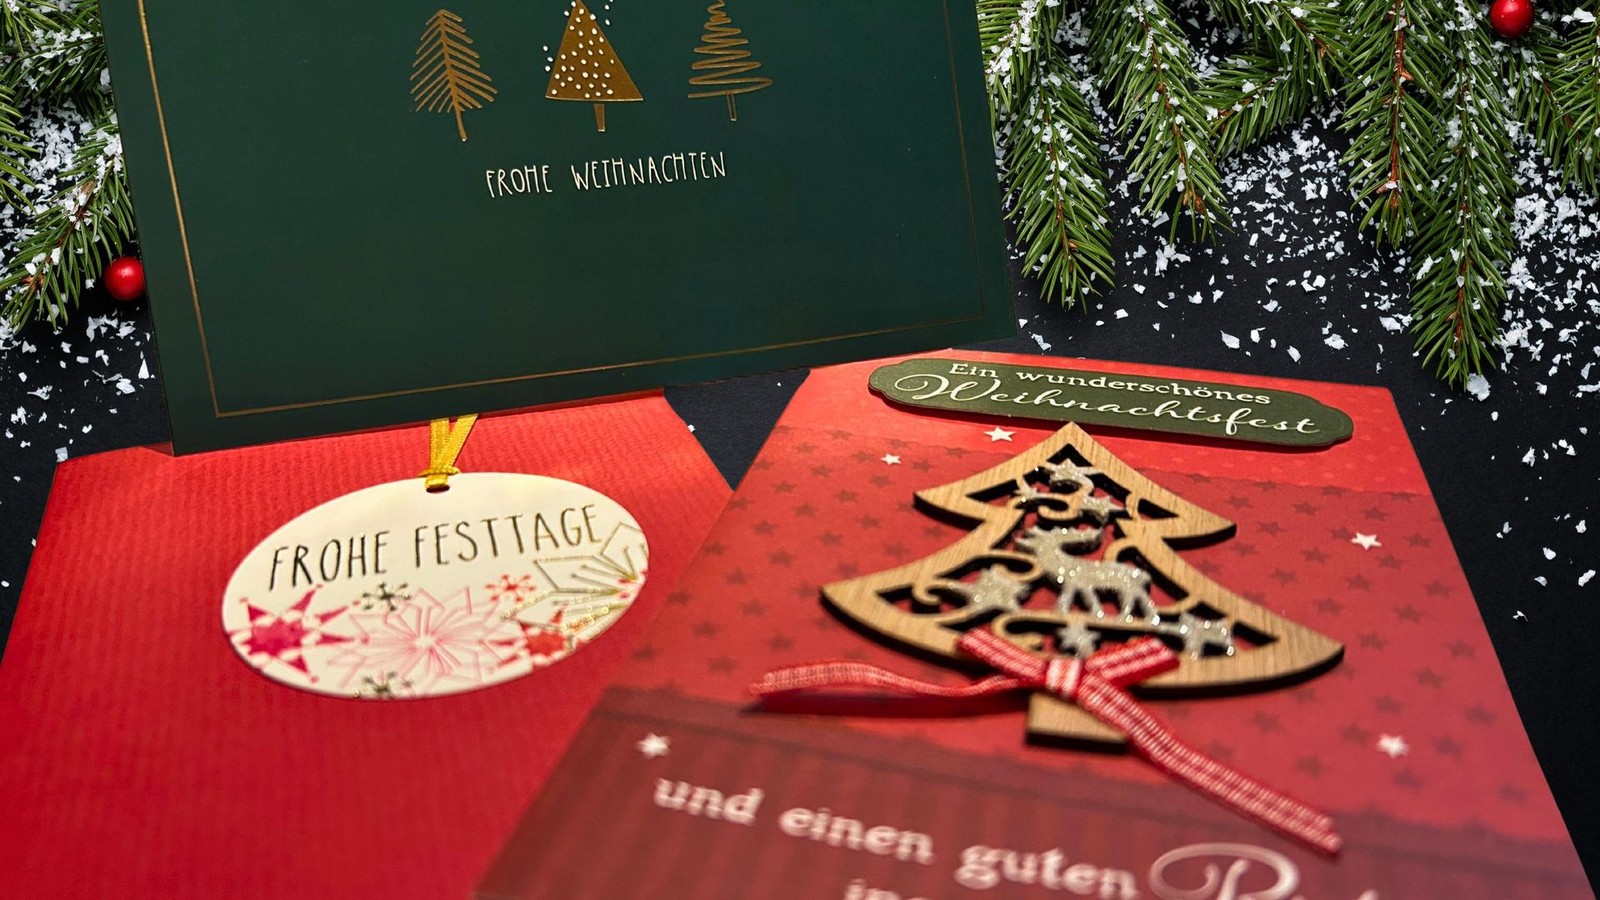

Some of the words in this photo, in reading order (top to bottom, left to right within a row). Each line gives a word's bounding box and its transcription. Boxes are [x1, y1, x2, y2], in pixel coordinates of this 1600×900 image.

[486, 165, 553, 198] FROHE
[571, 151, 727, 191] WEIHNACHTEN
[894, 374, 1320, 435] Weihnachtsfest
[949, 363, 999, 378] Ein
[1016, 371, 1271, 405] wunderschönes
[268, 531, 390, 591] FROHE
[415, 504, 602, 568] FESTTAGE
[654, 777, 763, 825] und
[779, 806, 933, 864] einen
[955, 844, 1138, 900] guten
